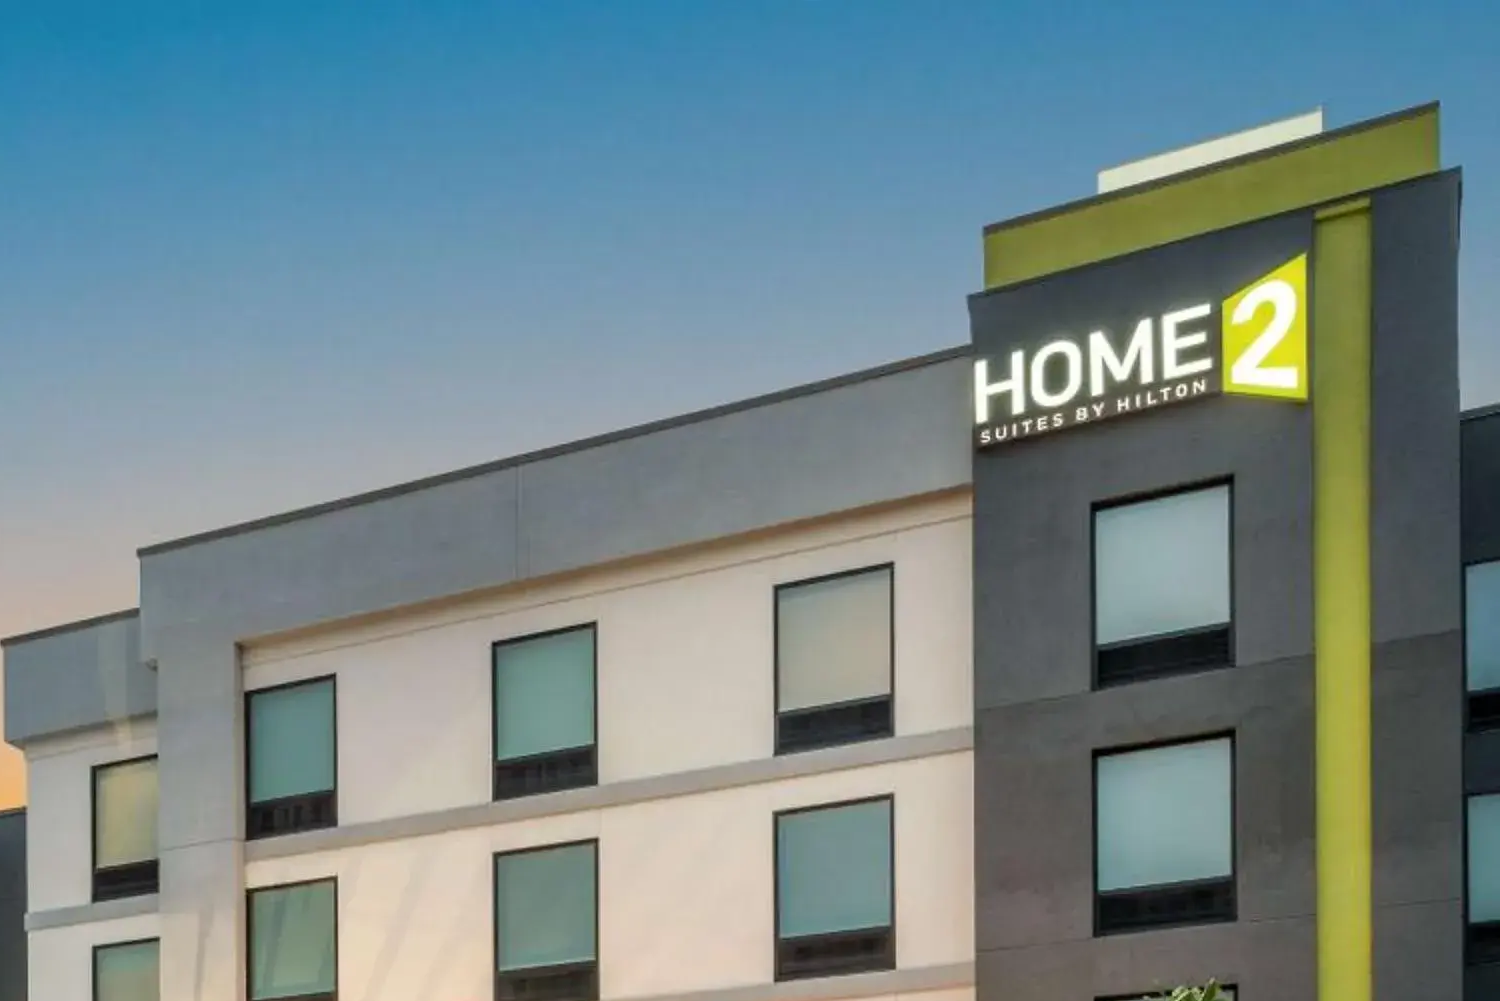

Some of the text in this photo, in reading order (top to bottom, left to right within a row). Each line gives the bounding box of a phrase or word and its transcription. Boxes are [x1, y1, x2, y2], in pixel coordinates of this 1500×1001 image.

[973, 278, 1298, 424] HOME 2
[979, 378, 1207, 444] SUITES BY HILTON
